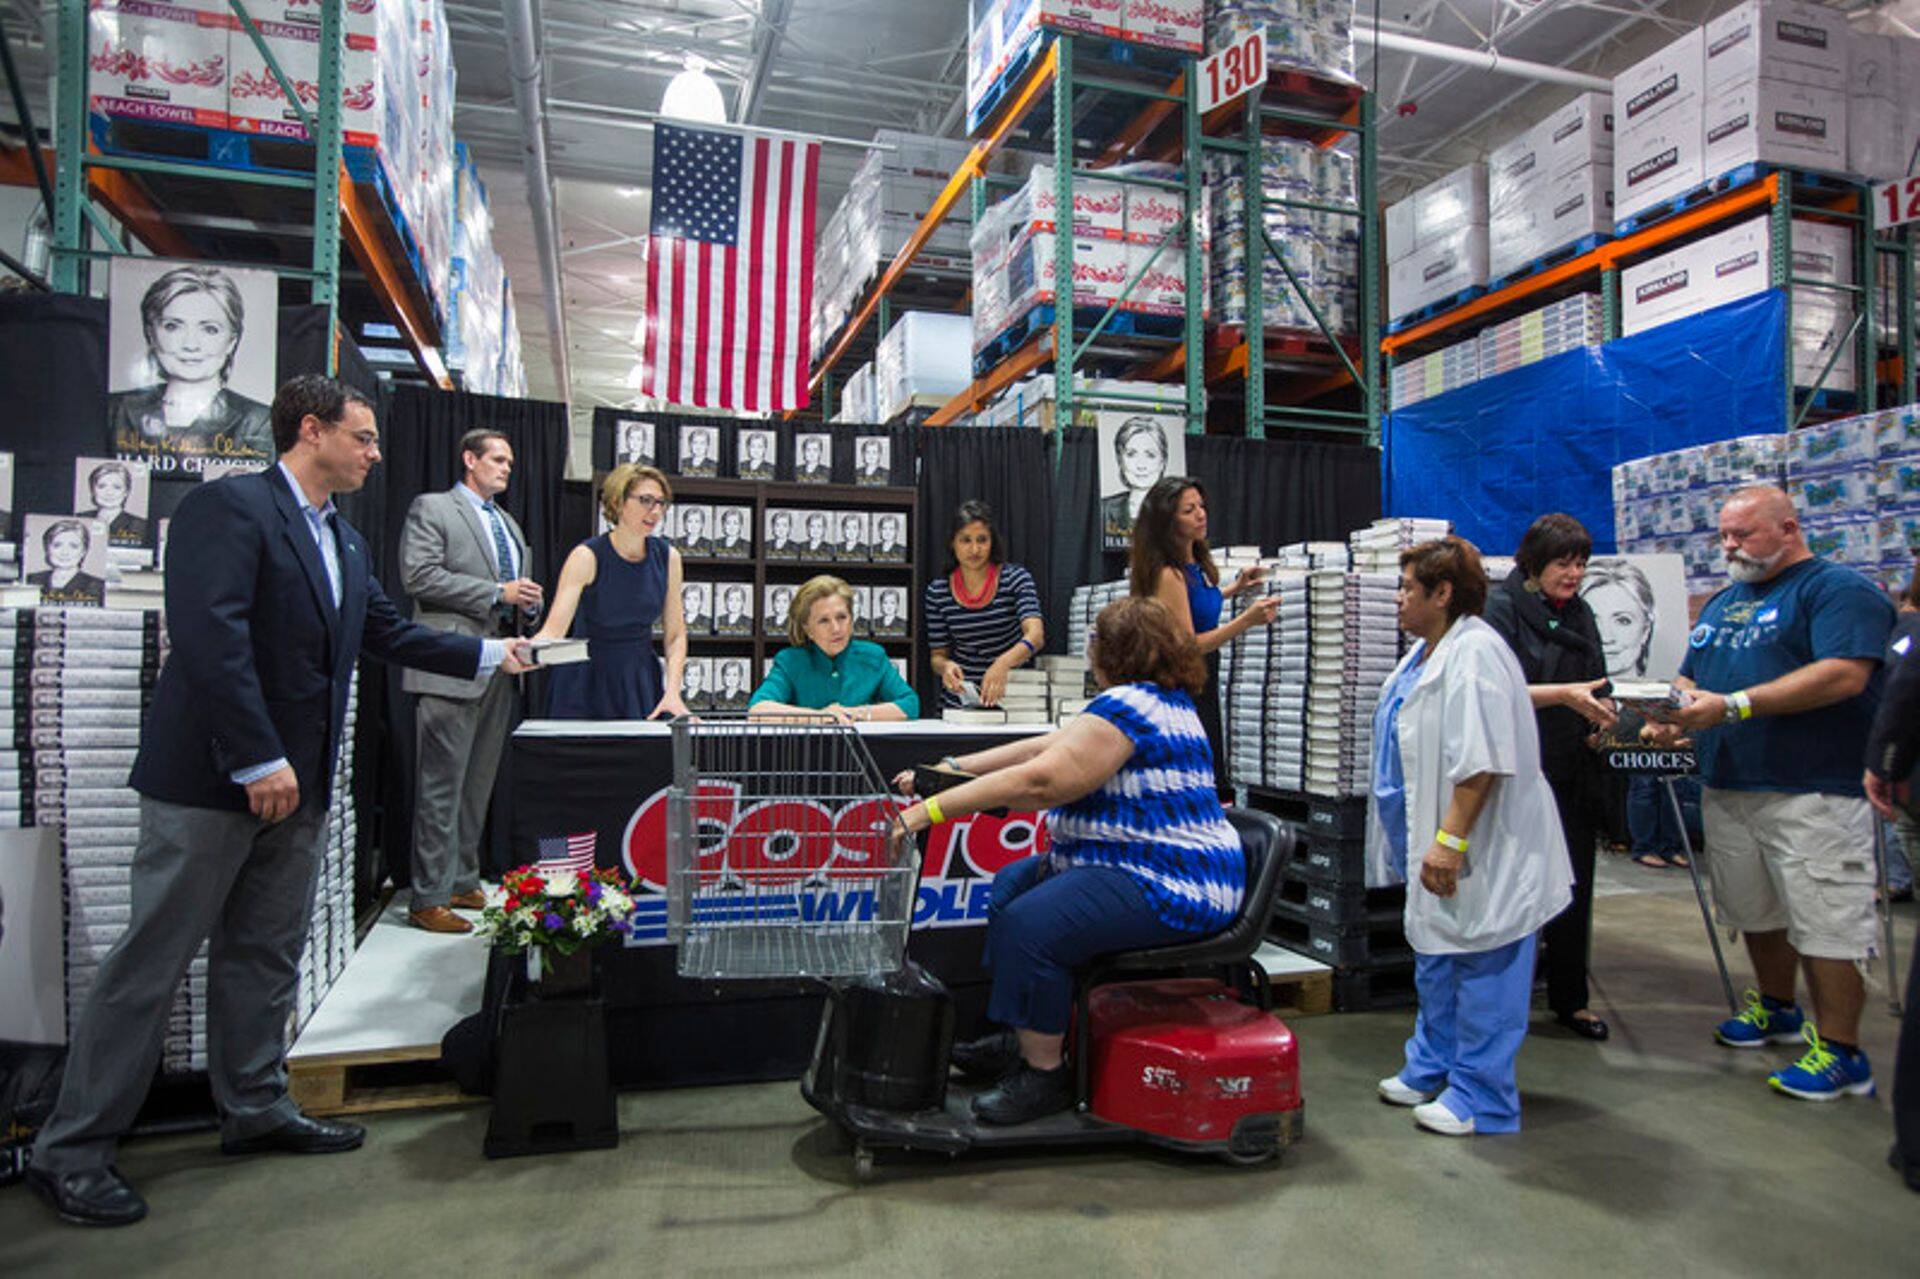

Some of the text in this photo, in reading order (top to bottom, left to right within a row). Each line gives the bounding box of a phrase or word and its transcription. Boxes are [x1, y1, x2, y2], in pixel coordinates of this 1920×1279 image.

[262, 20, 303, 41] BEACH
[1206, 34, 1262, 104] 130
[1629, 75, 1677, 110] KIRKLAND
[101, 99, 147, 117] BEACH
[148, 104, 195, 121] TOWEL
[260, 119, 304, 138] BEACH
[1629, 149, 1677, 180] KIRKLAND
[1638, 271, 1688, 296] KIRKLAND
[1608, 752, 1697, 769] CHOICES
